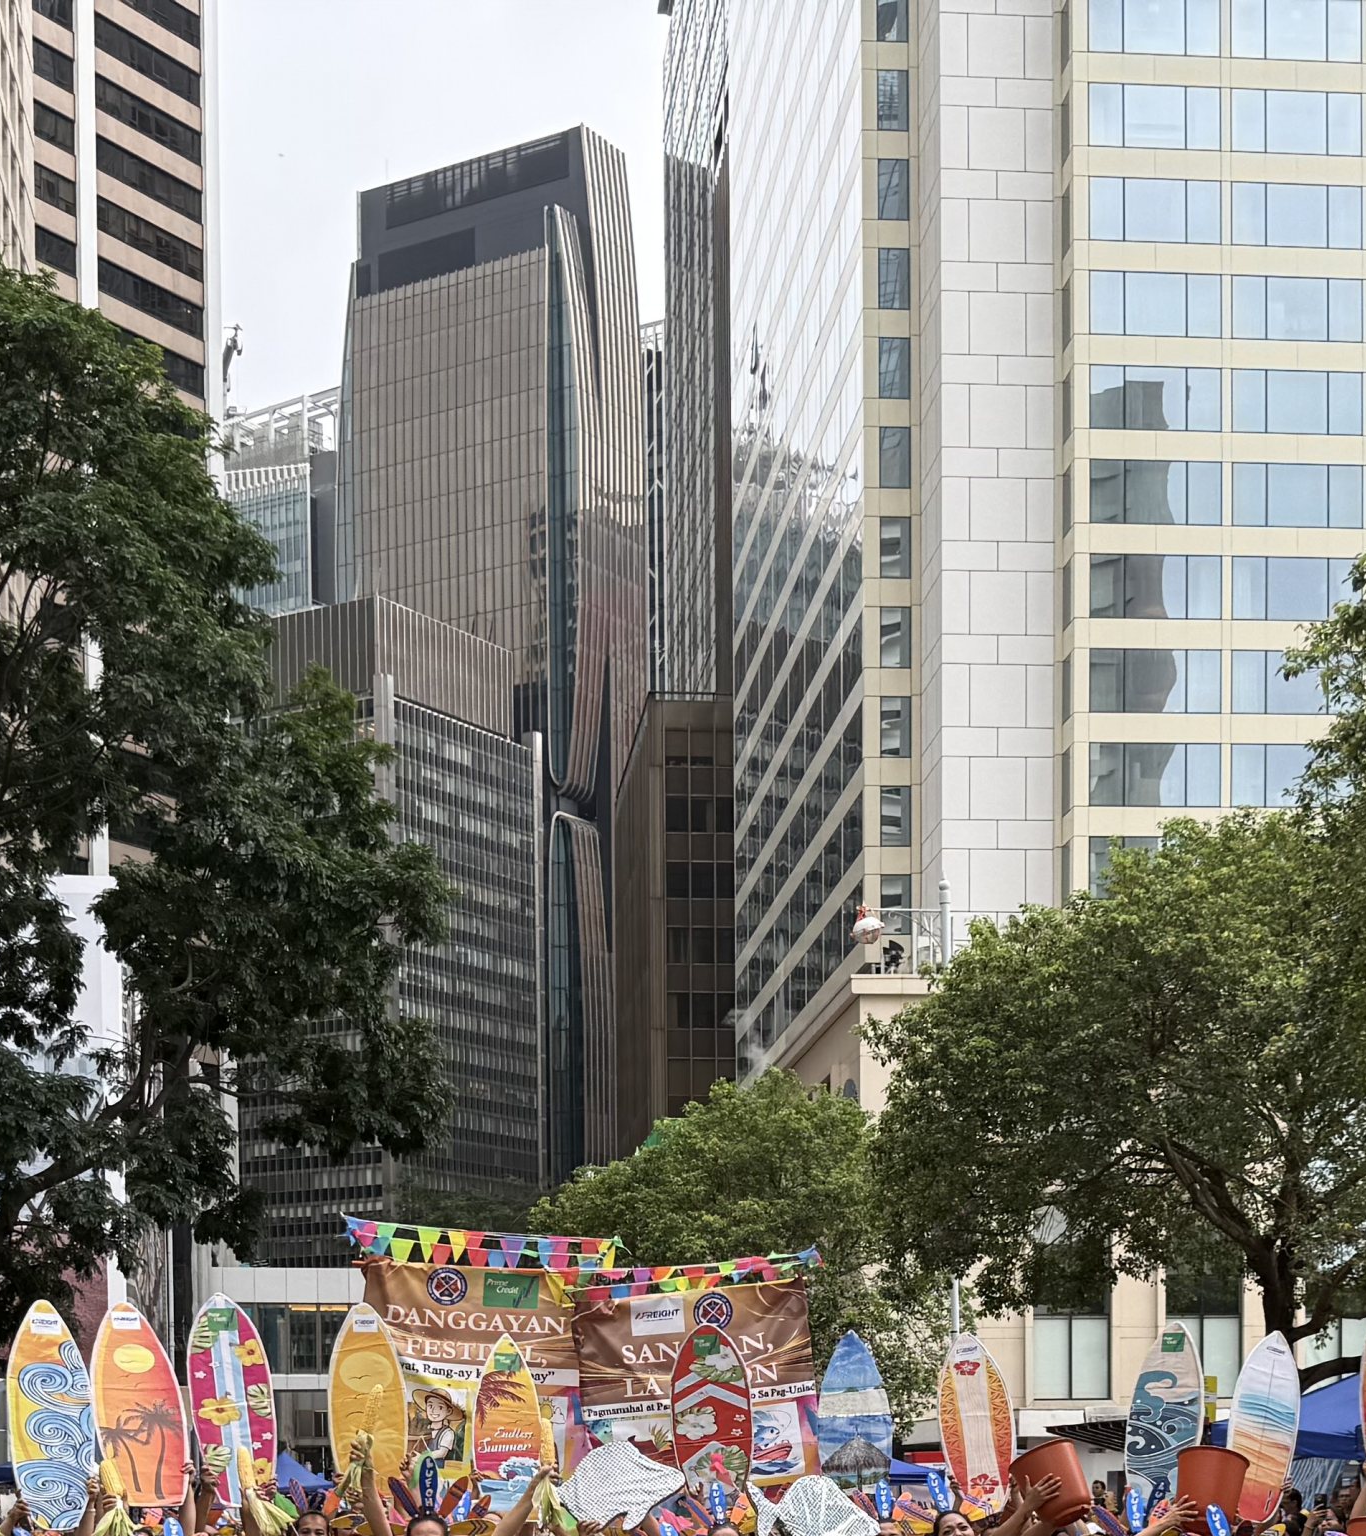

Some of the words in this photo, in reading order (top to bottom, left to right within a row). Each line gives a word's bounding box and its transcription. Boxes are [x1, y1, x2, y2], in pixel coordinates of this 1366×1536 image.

[496, 1285, 519, 1295] Credit
[385, 1304, 566, 1334] DANGGAYAN
[406, 1337, 548, 1367] FESTIL,
[424, 1364, 472, 1380] Rang-ay
[623, 1375, 664, 1398] LA
[758, 1389, 769, 1398] Sa
[494, 1427, 533, 1440] Endless
[478, 1437, 532, 1453] Summer
[426, 1457, 434, 1507] LUFOH
